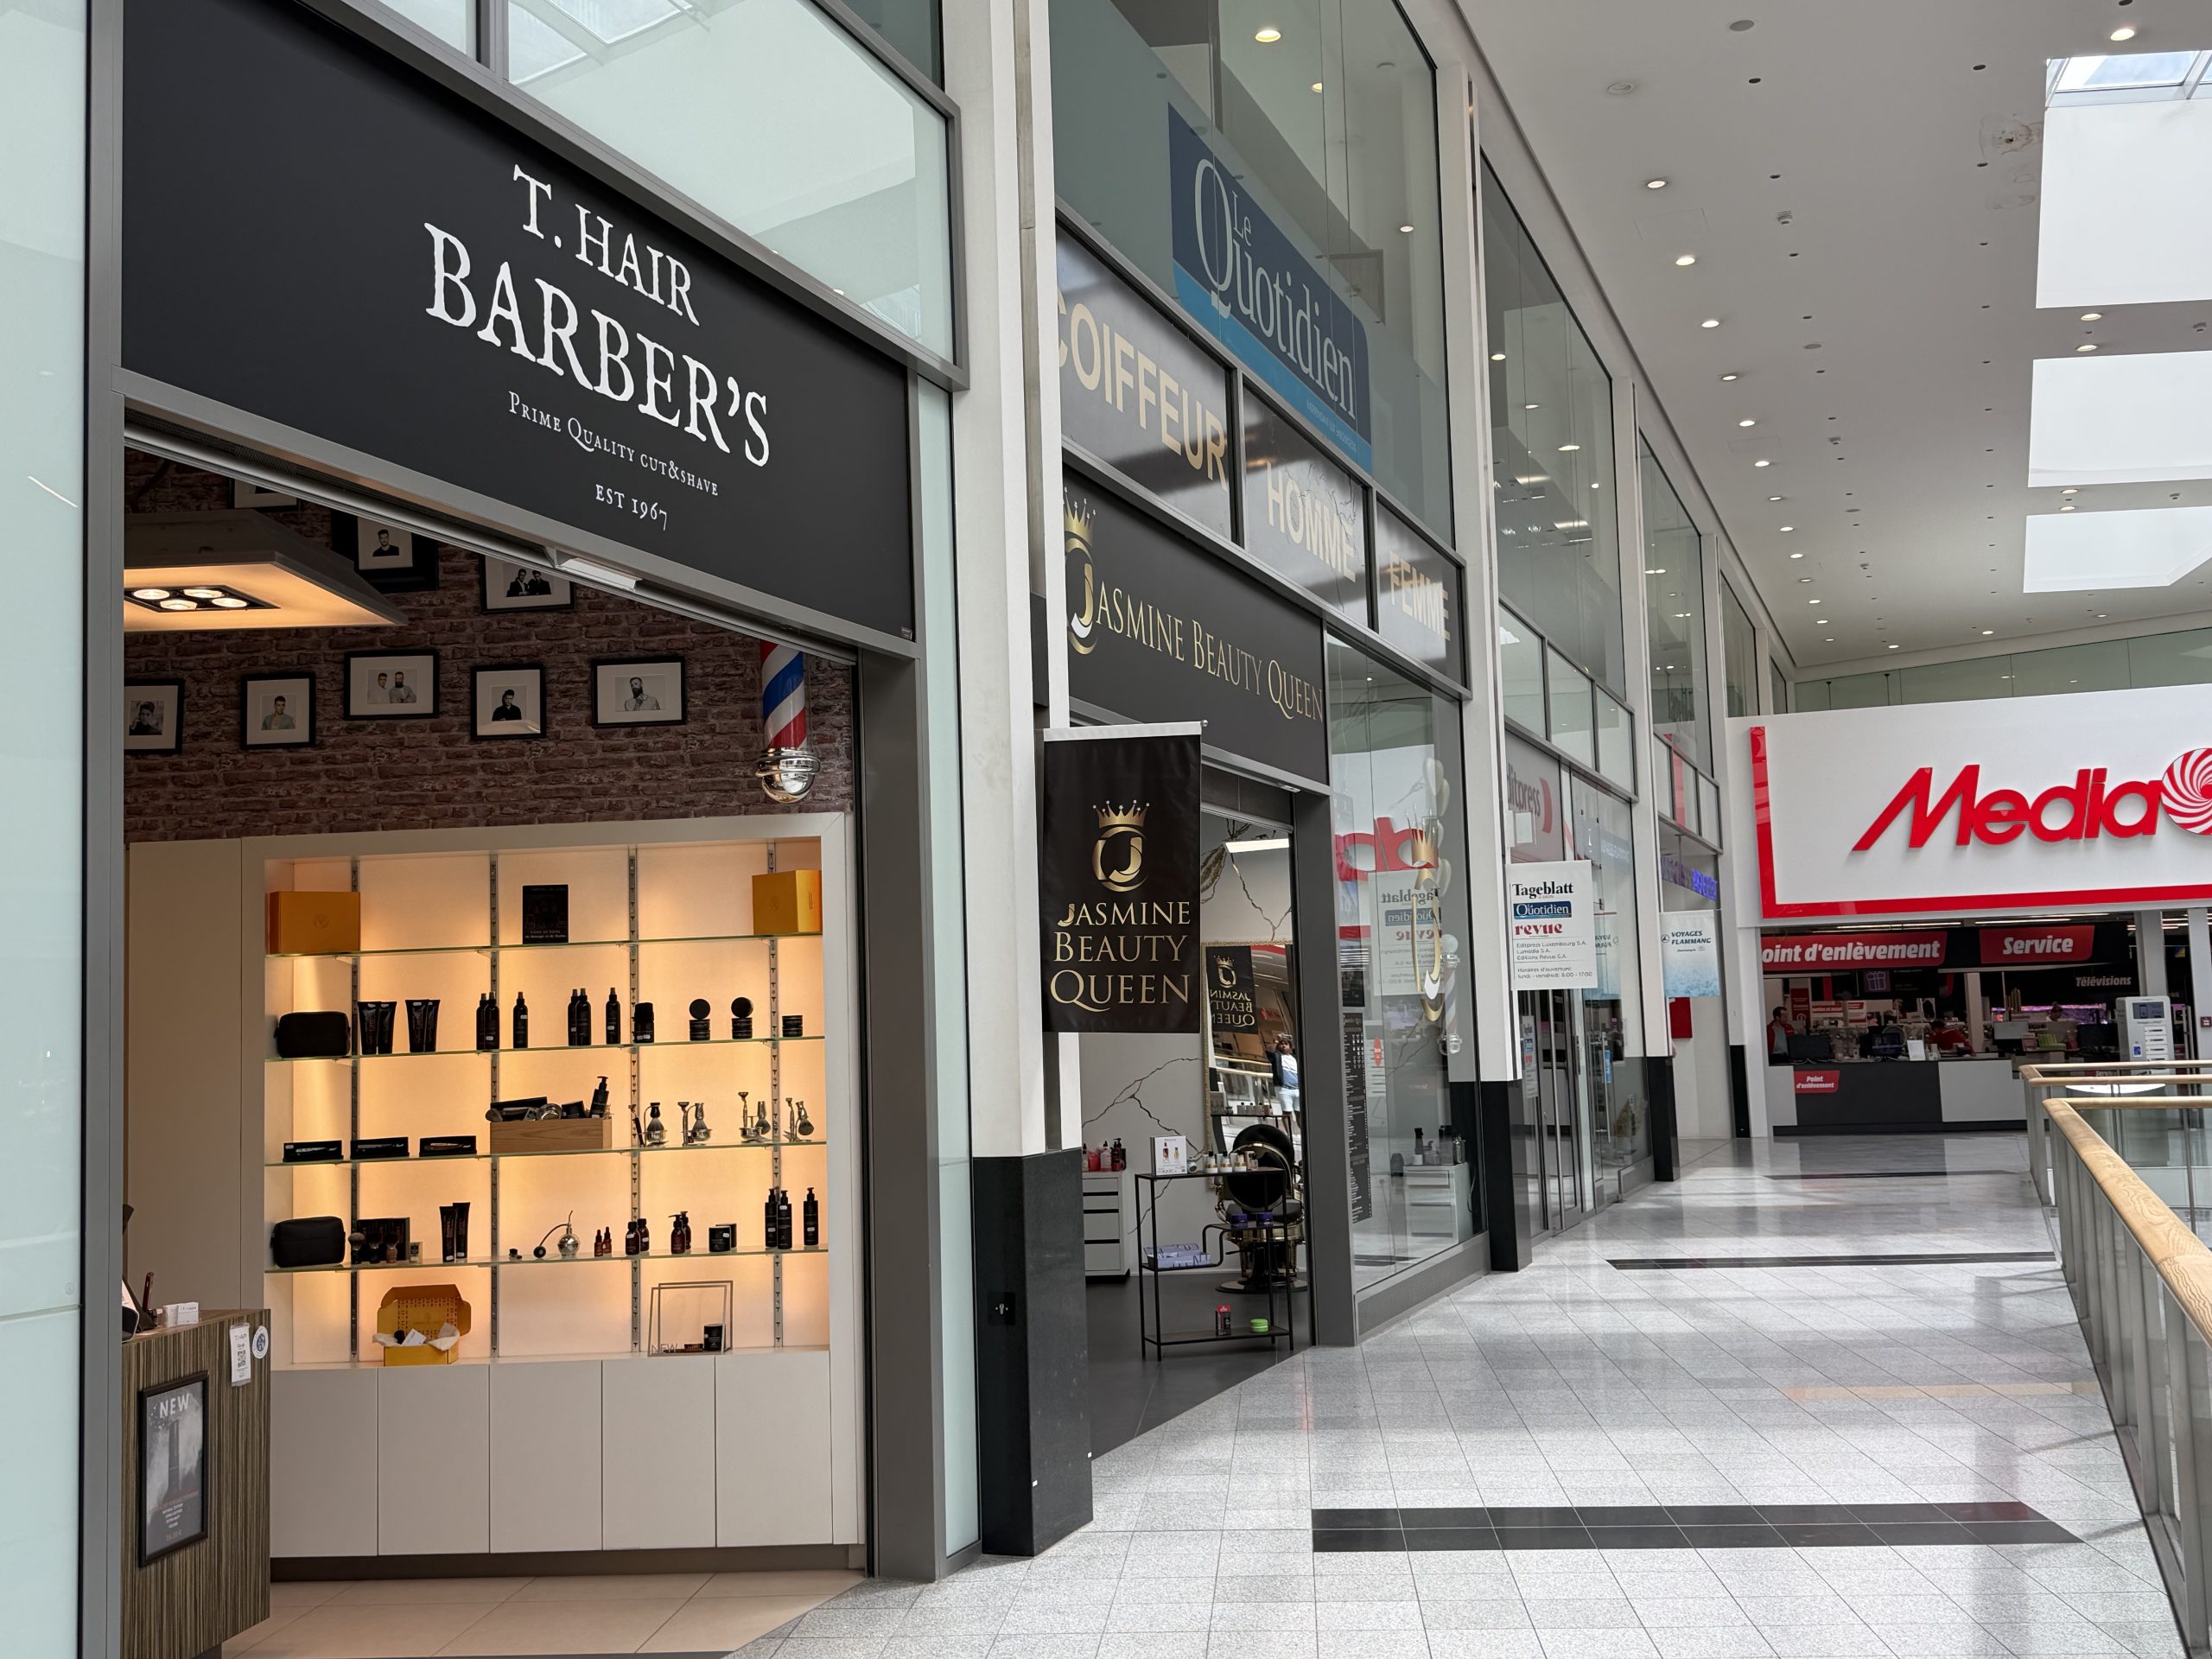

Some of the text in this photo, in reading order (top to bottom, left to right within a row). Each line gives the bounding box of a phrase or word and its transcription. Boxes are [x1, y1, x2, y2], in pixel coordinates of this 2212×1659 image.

[1231, 189, 1251, 247] Le
[513, 163, 700, 327] T. HAIR
[1195, 159, 1356, 421] Quotidien
[424, 222, 770, 467] BARBER'S
[508, 391, 719, 497] PRIME QUALITY CUT&SHAVE
[595, 484, 668, 531] EST 1967
[1266, 460, 1357, 583] HOMME
[1389, 549, 1451, 641] FEMME
[1191, 620, 1262, 696] BEAUTY
[1268, 659, 1324, 723] QUEEN
[1853, 764, 2163, 851] Media
[1512, 880, 1573, 899] Tageblatt
[1516, 904, 1570, 918] Quotidien
[1057, 901, 1191, 927] JASMINE
[1515, 924, 1563, 936] revue
[1053, 931, 1188, 963] BEAUTY
[1804, 940, 1941, 963] d'enlèvement
[2003, 935, 2074, 955] Service
[1050, 969, 1191, 1013] QUEEN
[2075, 976, 2133, 987] Télévisions
[160, 1393, 190, 1419] NEW
